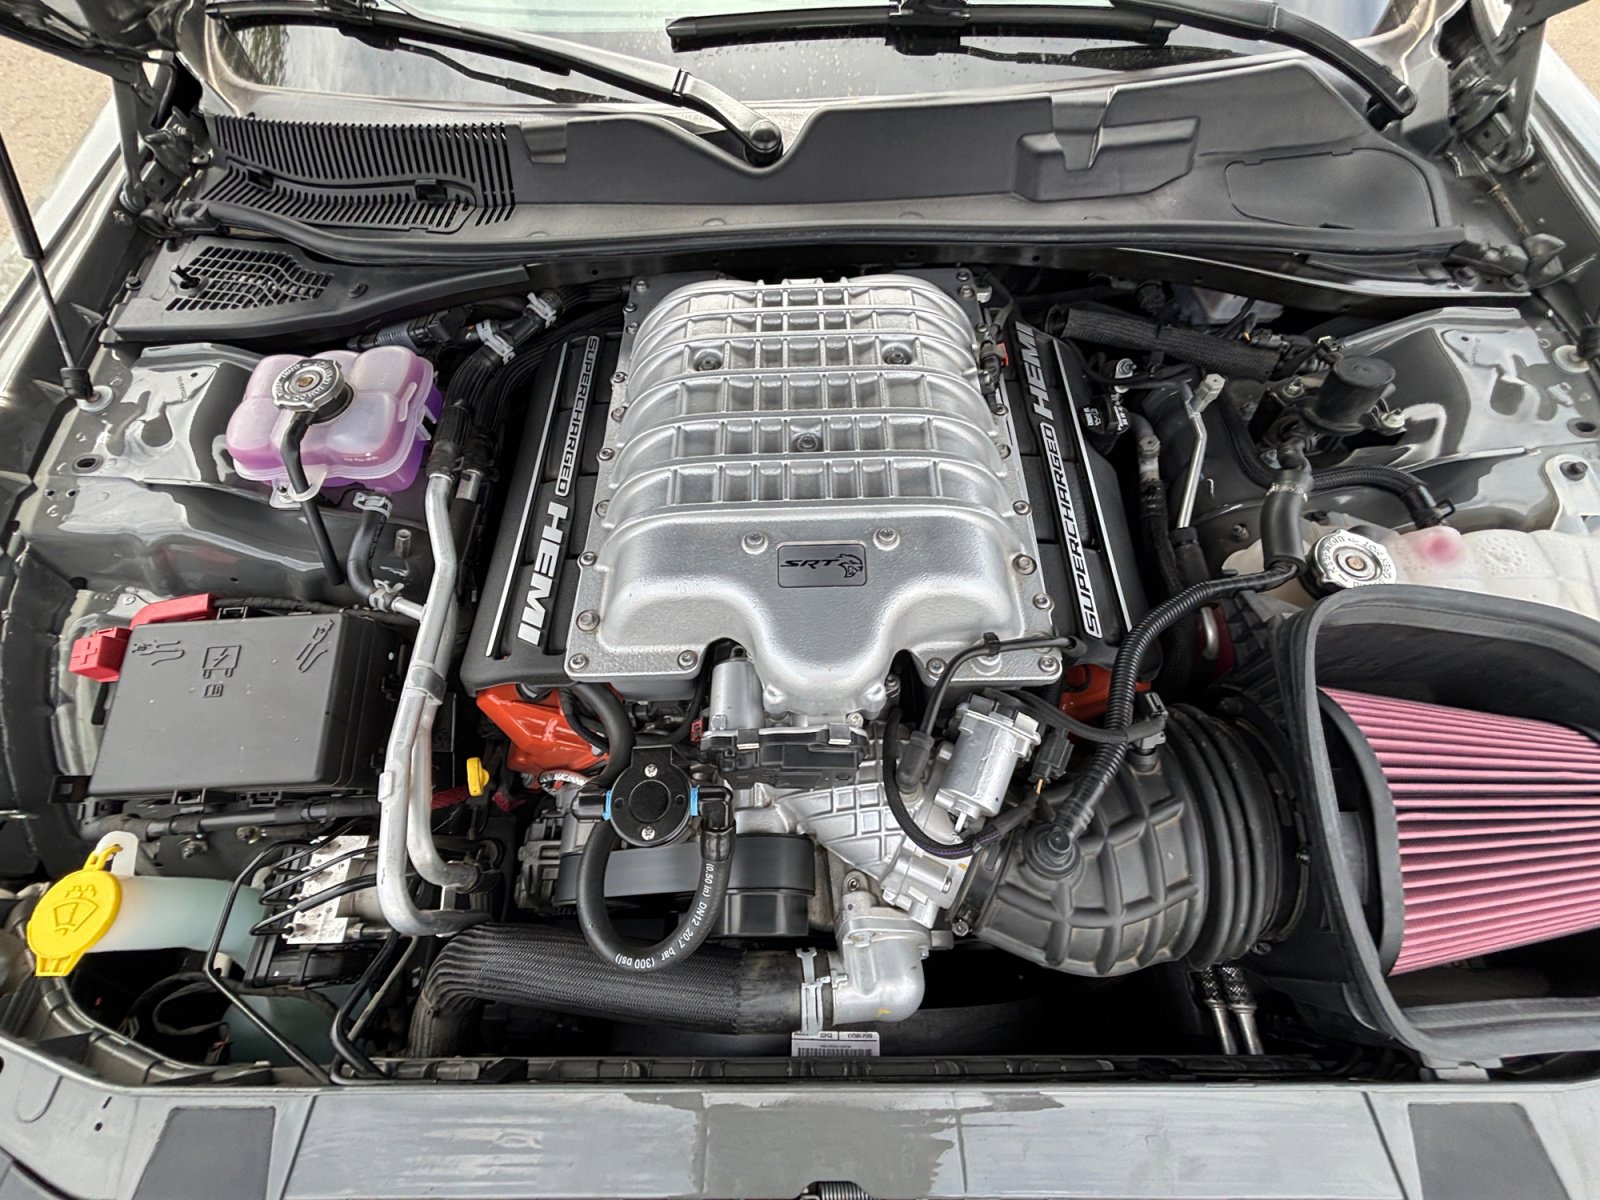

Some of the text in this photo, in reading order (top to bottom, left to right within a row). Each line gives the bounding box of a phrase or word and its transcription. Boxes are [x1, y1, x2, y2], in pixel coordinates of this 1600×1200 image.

[1015, 321, 1100, 636] SUPERCHARGED HEMI
[518, 337, 598, 646] SUPERCHARGED HEMI
[780, 559, 840, 570] SRT
[704, 863, 714, 884] (0.50
[691, 901, 707, 926] DN12
[678, 927, 694, 949] 20.7
[615, 953, 632, 966] psi)
[634, 957, 655, 969] (300
[661, 946, 676, 961] bar
